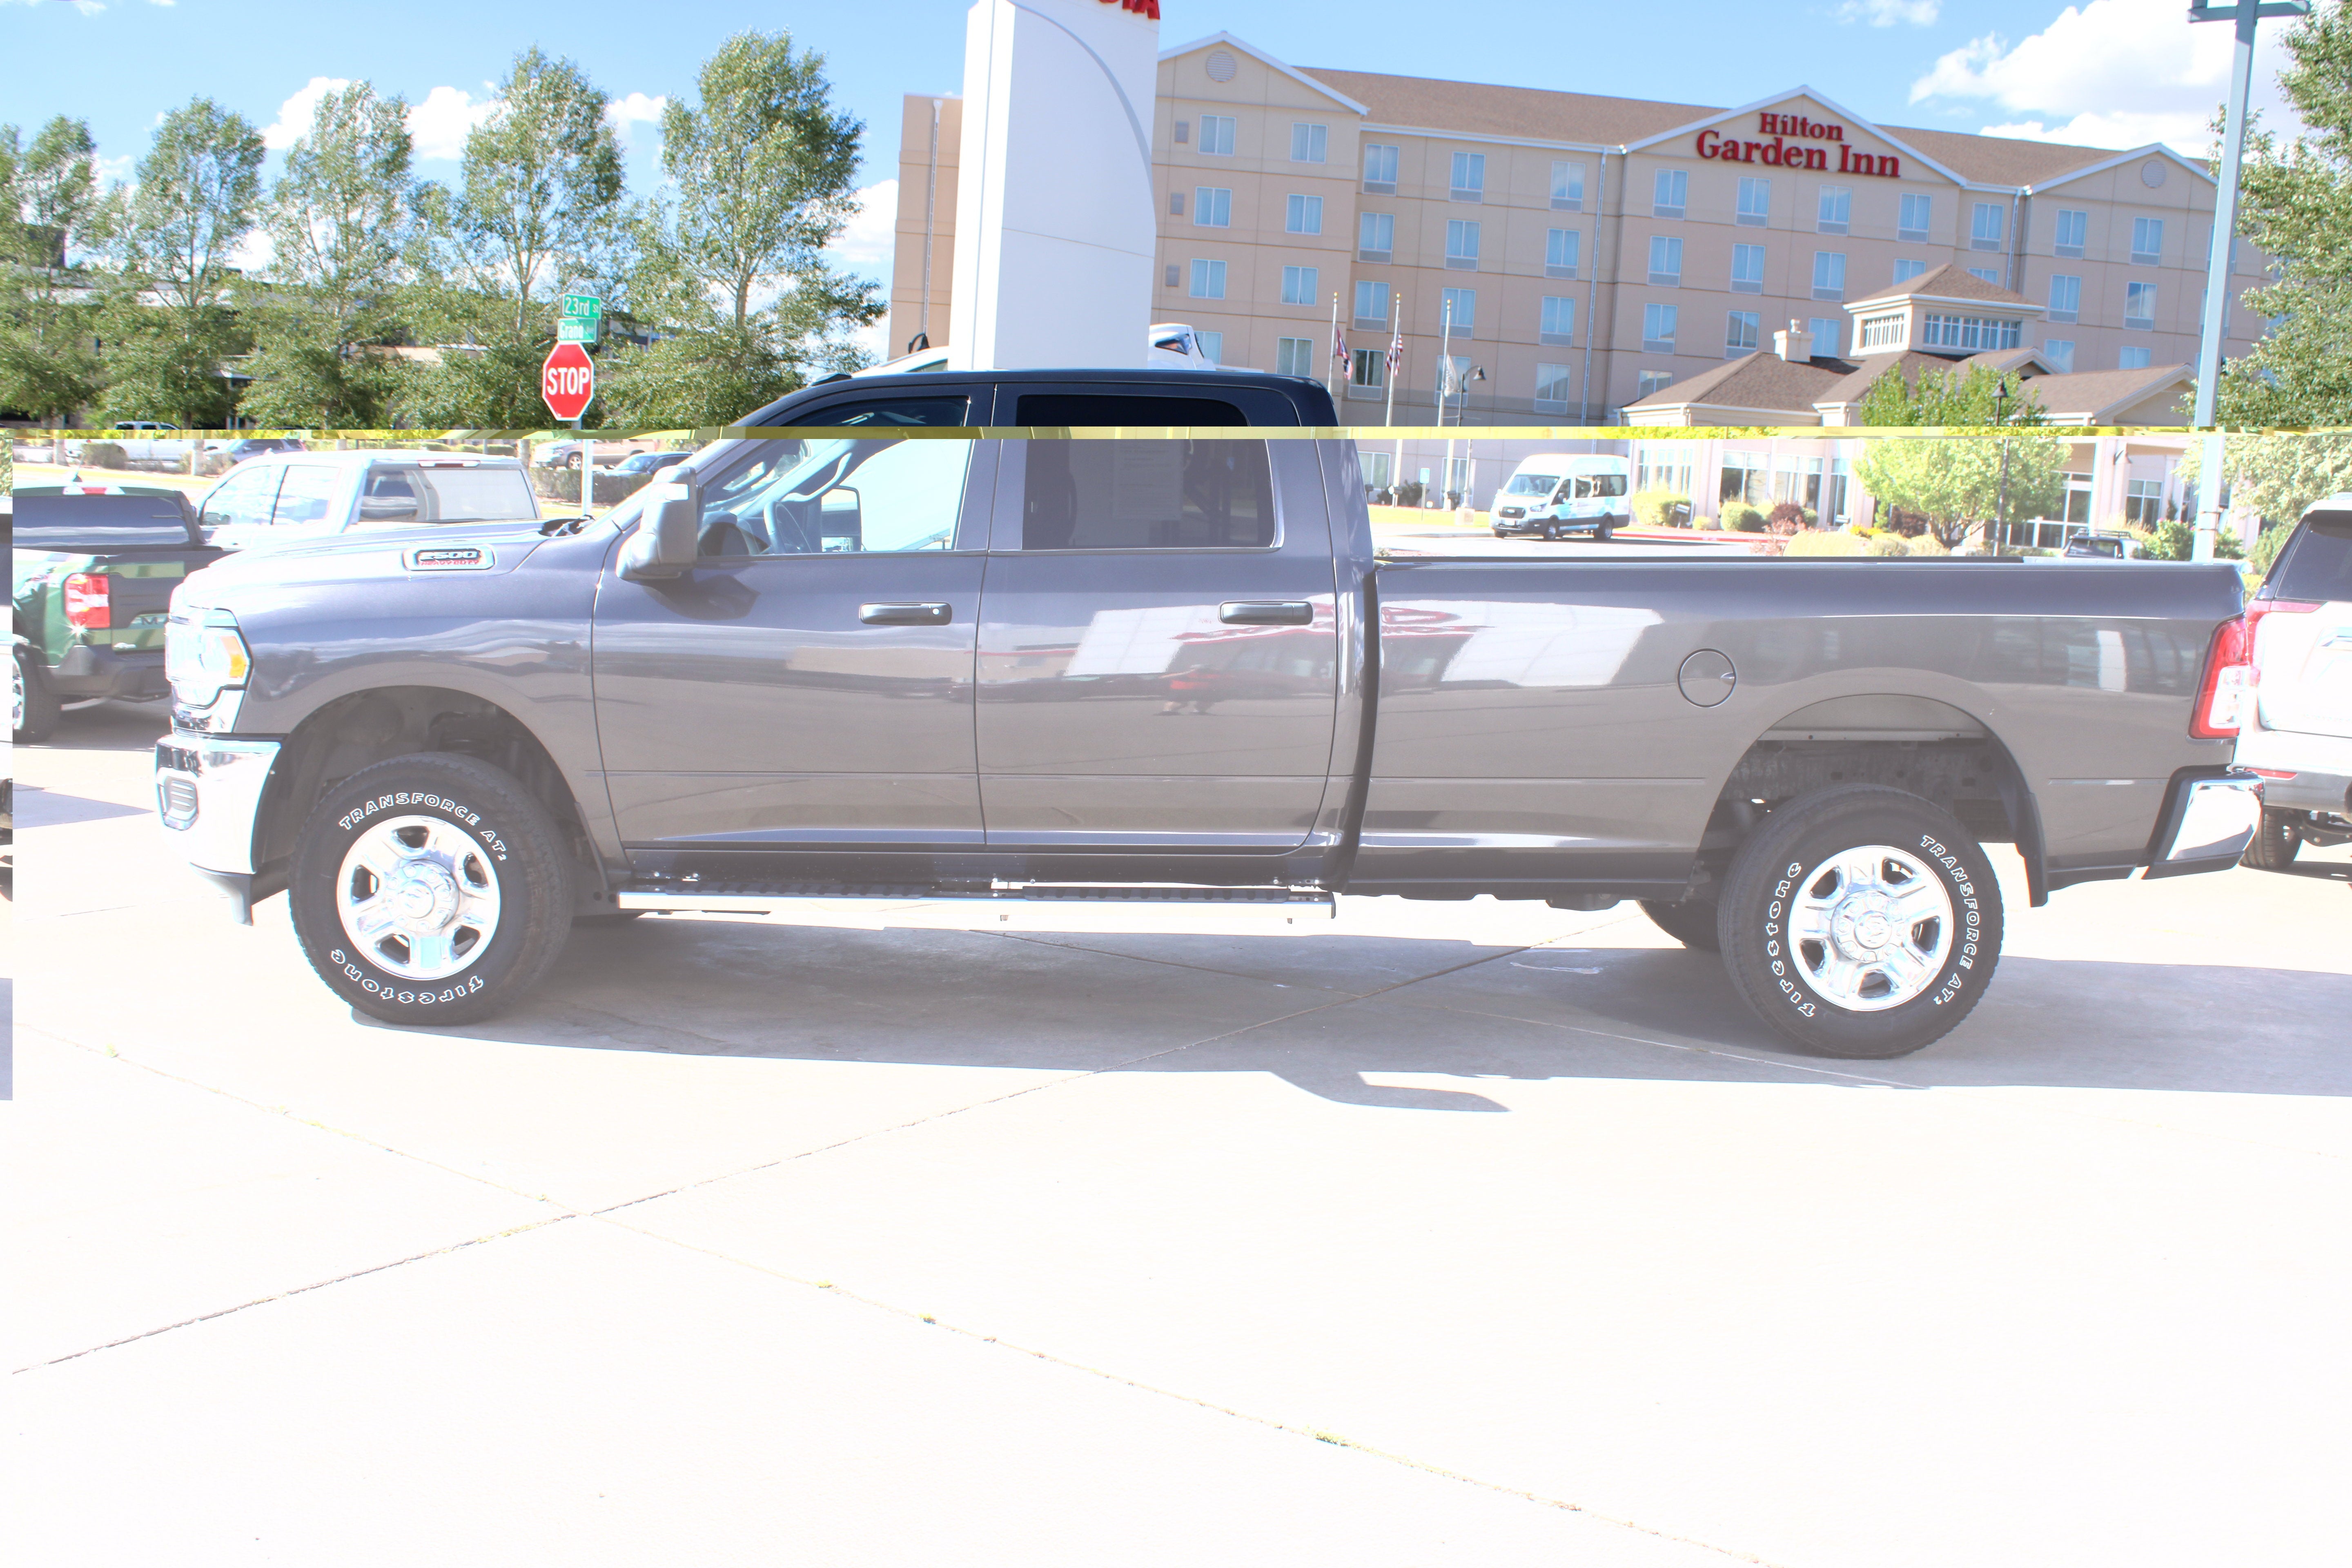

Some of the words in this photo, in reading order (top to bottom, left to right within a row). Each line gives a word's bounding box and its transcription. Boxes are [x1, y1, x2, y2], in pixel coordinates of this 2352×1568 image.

[1759, 112, 1844, 141] Hilton
[1697, 129, 1828, 170] Garden
[1838, 144, 1900, 178] Inn
[565, 296, 590, 316] 23rd
[560, 321, 584, 340] Grand
[547, 367, 590, 395] STOP
[419, 551, 478, 560] 2500
[339, 792, 481, 830] TRANSFORCE
[1920, 835, 1980, 970] TRANSFORCE
